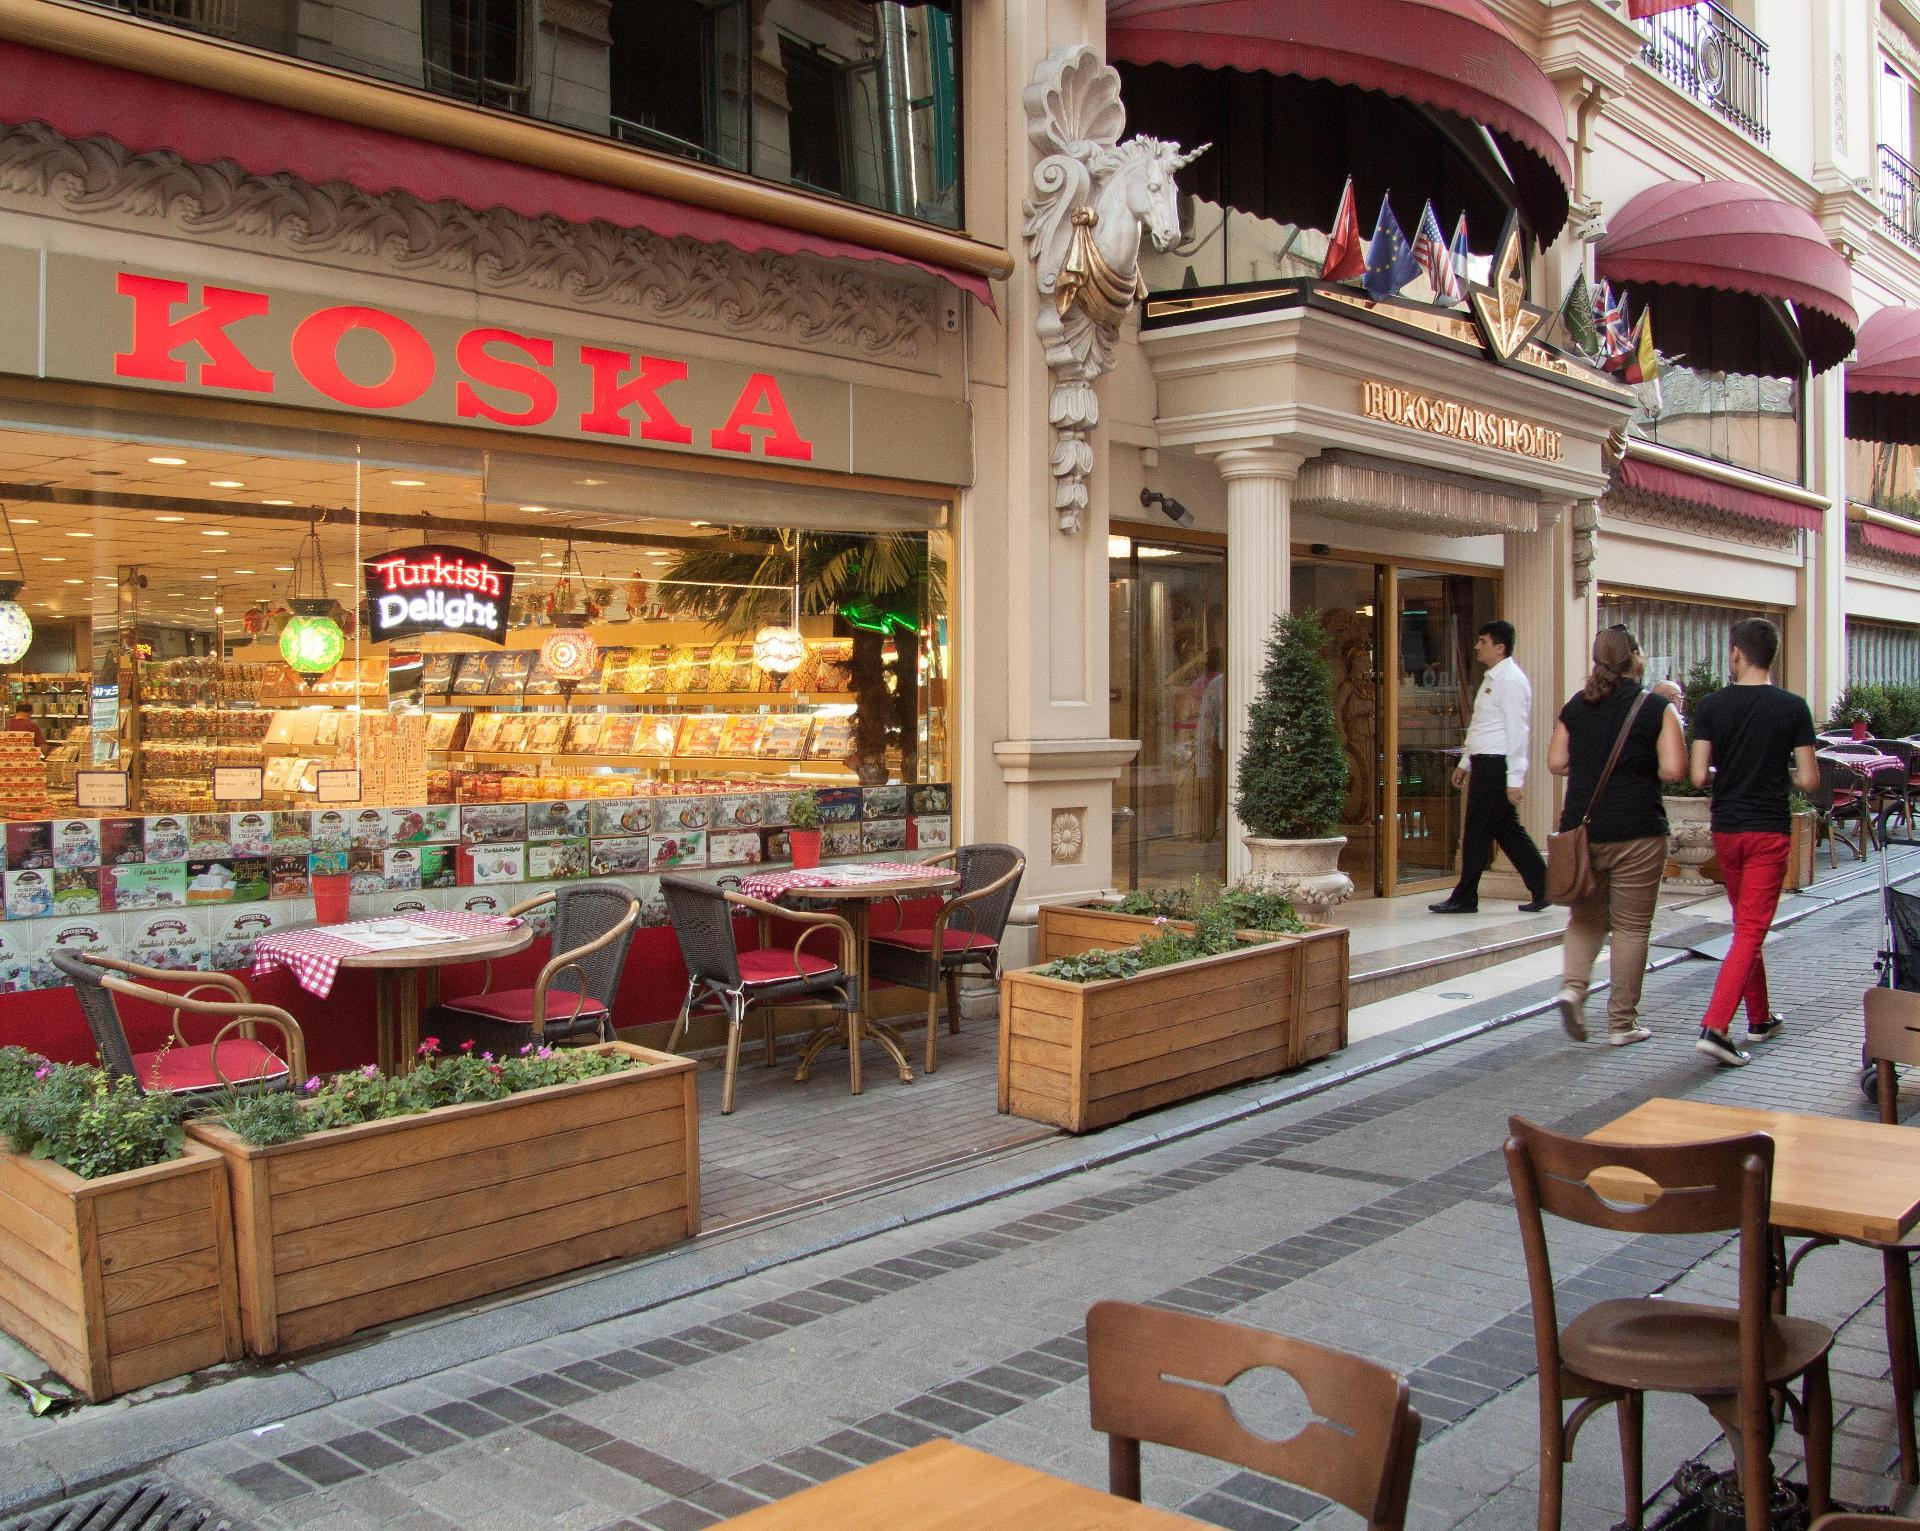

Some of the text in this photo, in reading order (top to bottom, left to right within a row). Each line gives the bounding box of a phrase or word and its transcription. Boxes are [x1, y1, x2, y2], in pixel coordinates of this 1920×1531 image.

[114, 272, 812, 461] KOSKA
[377, 554, 500, 595] Turkish
[379, 589, 498, 630] Delight
[397, 901, 421, 910] KOSKA
[239, 914, 267, 922] KOSKA
[154, 920, 183, 928] KOSKA
[62, 927, 93, 935] KOSKA
[224, 931, 250, 942] Turkish
[138, 936, 197, 949] Turkish Delight
